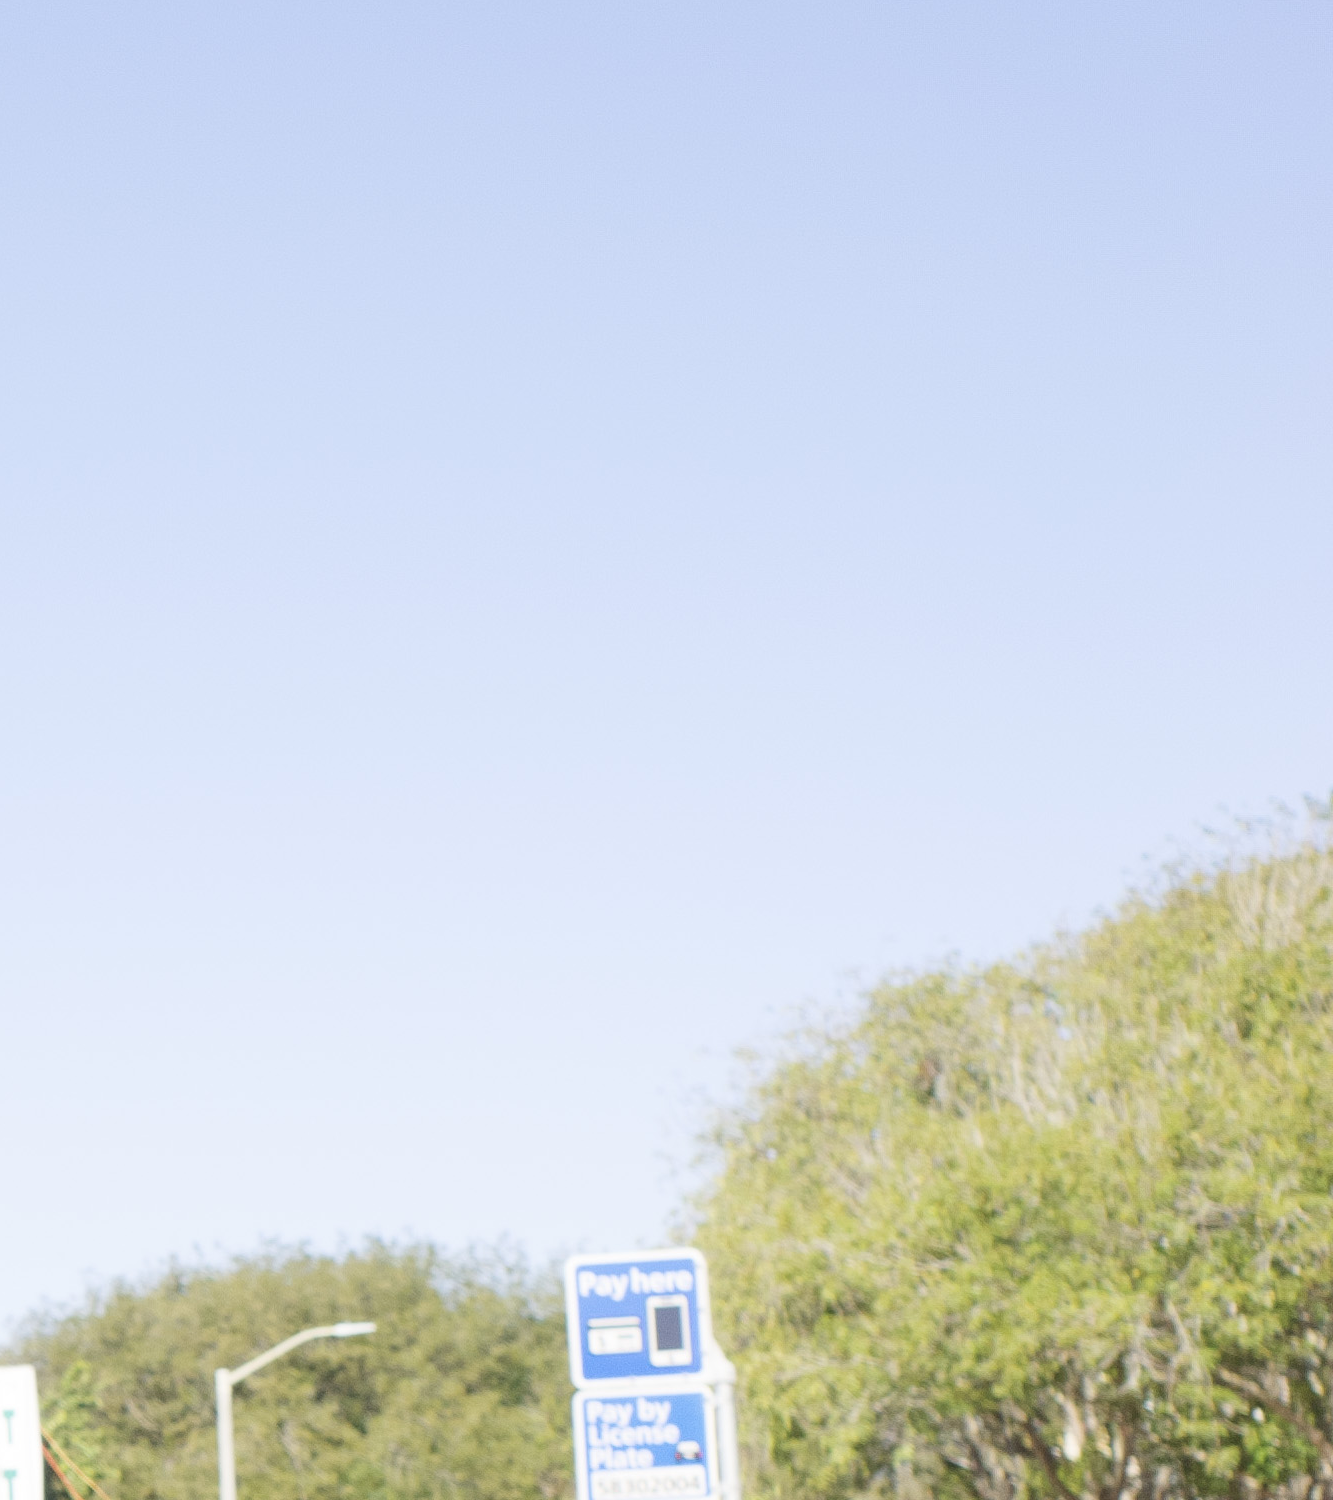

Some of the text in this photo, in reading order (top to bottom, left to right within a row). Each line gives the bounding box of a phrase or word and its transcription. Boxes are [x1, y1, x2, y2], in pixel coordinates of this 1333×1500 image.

[578, 1267, 694, 1302] Pay here
[586, 1396, 671, 1426] Pay by
[588, 1422, 681, 1447] License
[589, 1445, 655, 1471] Plate
